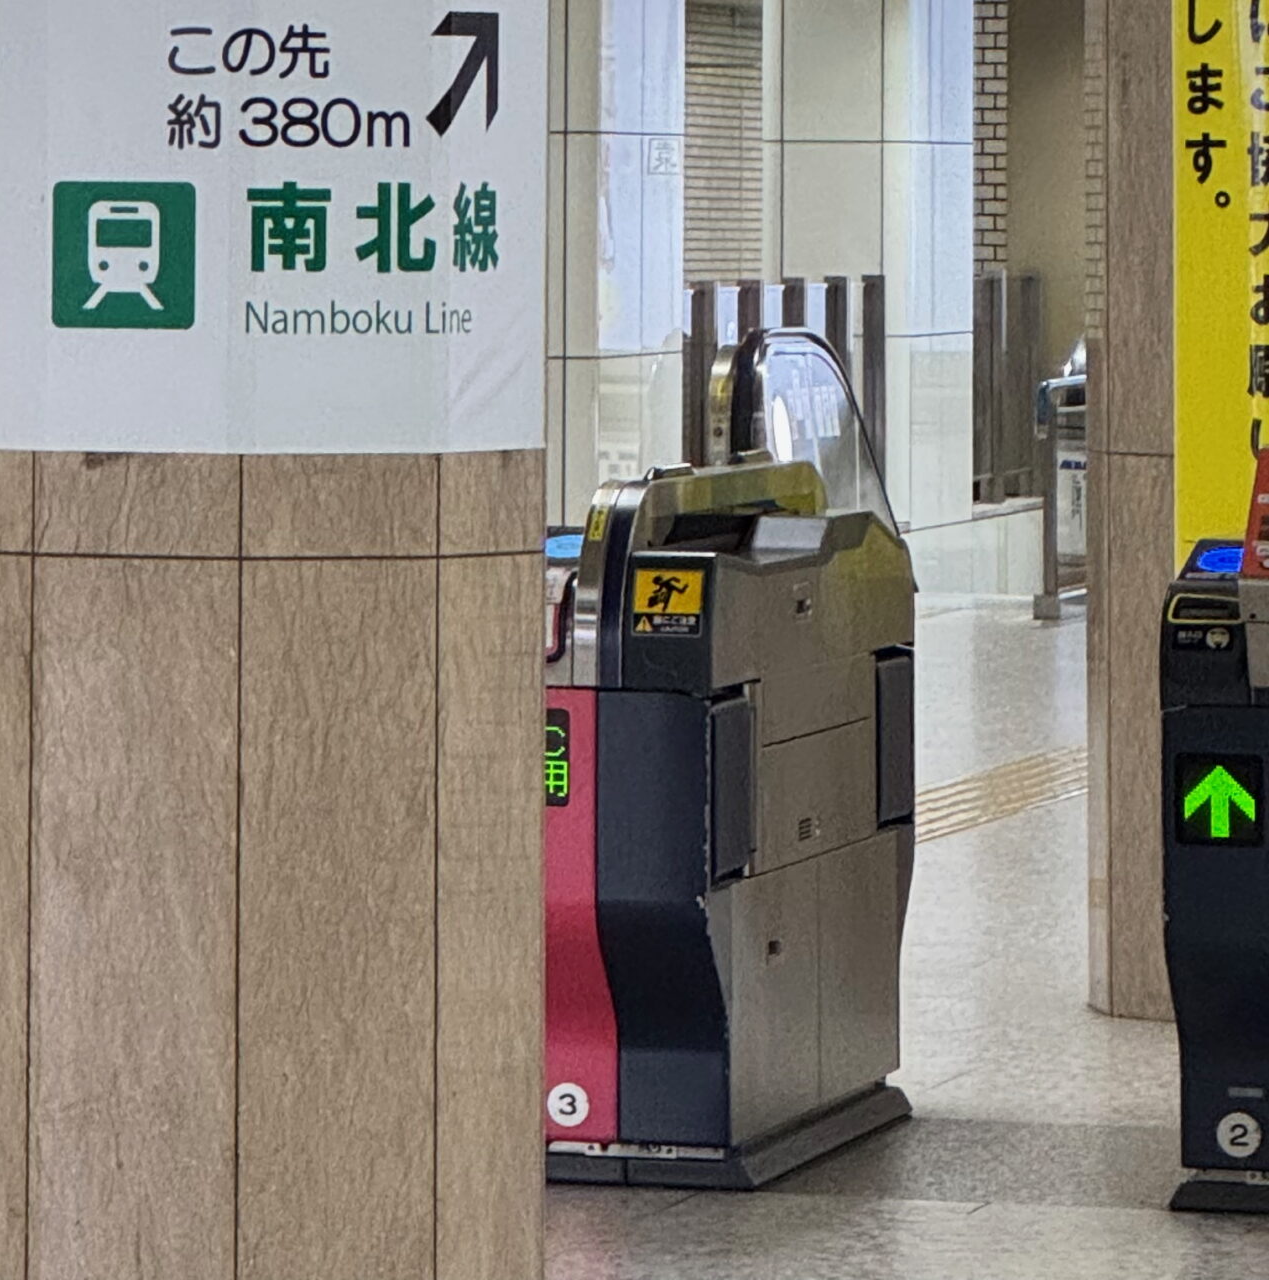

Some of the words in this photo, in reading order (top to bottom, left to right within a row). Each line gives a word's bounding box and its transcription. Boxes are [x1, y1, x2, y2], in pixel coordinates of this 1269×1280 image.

[167, 23, 331, 80] この先
[246, 181, 499, 274] 南北線
[245, 299, 413, 335] Namboku
[425, 300, 472, 335] Line
[559, 1093, 577, 1116] 3
[1230, 1123, 1249, 1147] 2
